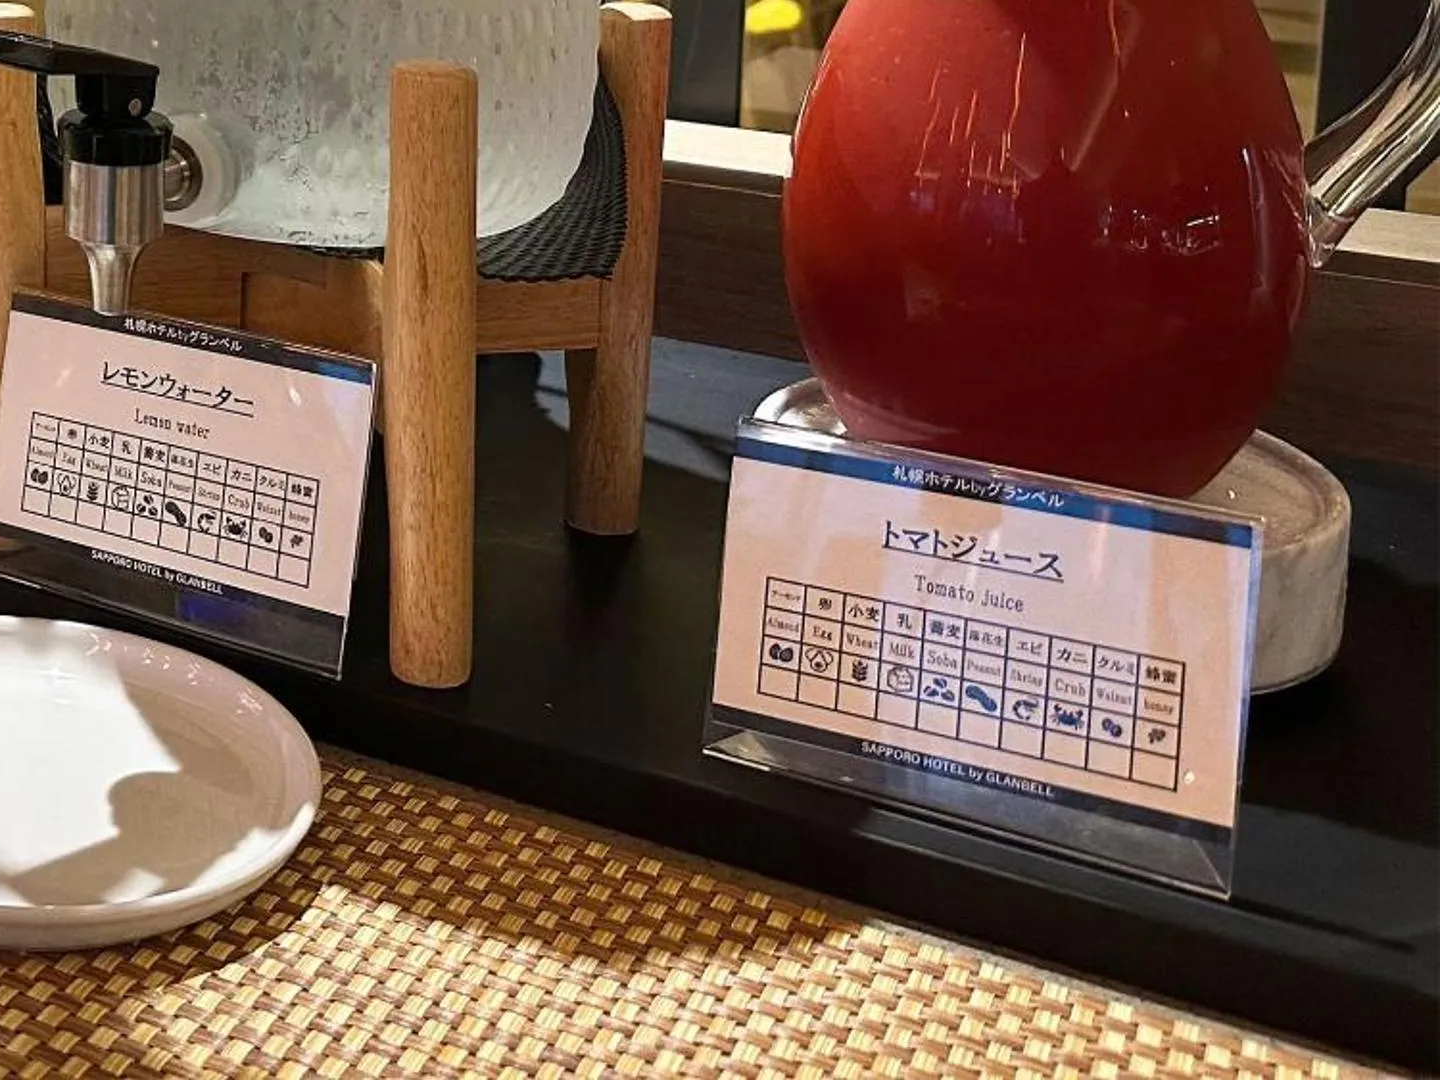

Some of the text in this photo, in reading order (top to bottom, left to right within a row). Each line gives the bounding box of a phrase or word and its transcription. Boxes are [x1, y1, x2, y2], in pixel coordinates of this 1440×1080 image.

[101, 361, 254, 408] レモンウォーター
[230, 469, 252, 482] カニ
[892, 464, 1064, 507] 札幌ホテルbyグランベル
[133, 560, 162, 578] HOTEL
[883, 520, 1063, 579] トマトジュース
[914, 574, 1024, 612] Tomato juice
[848, 603, 880, 622] 小麦
[897, 613, 913, 630] 乳
[1016, 640, 1043, 656] エビ
[1056, 647, 1089, 664] カニ
[1097, 656, 1136, 676] クルミ
[889, 642, 914, 660] Milk
[927, 650, 957, 669] Soba
[861, 740, 1055, 797] SAPPORO HOTEL by GLANBELL
